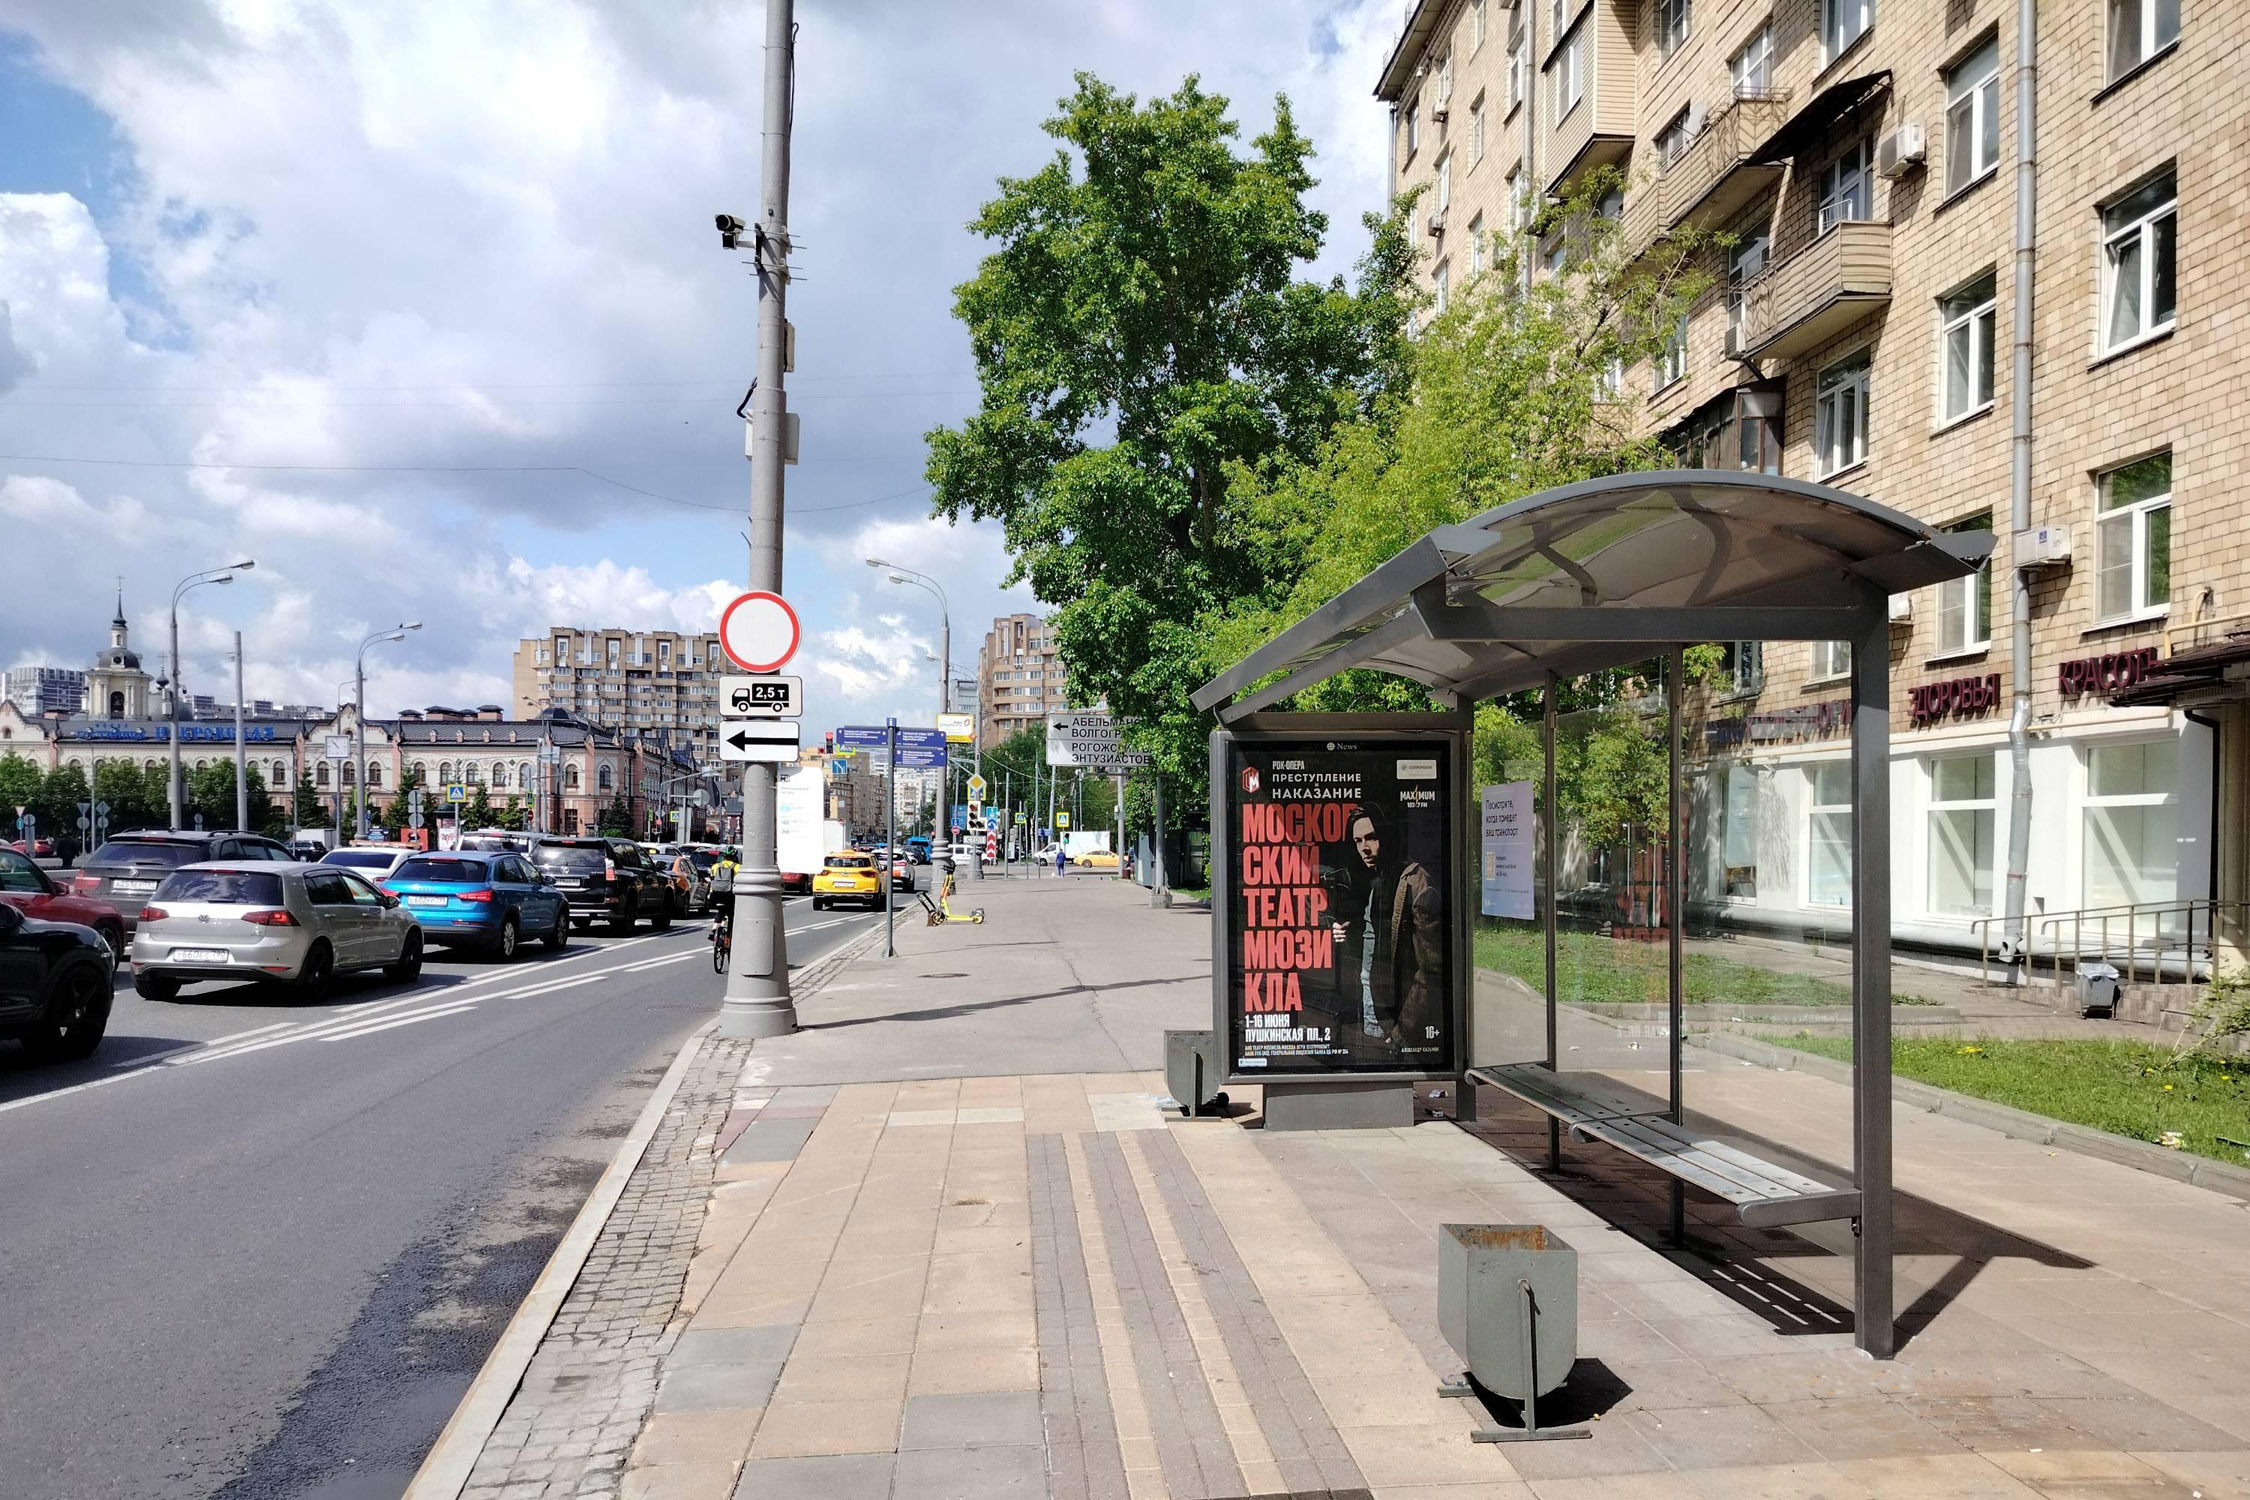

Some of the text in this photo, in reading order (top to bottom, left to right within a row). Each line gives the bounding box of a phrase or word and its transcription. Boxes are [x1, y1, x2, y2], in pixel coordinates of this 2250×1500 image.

[755, 686, 775, 700] 2,5
[1907, 673, 2000, 721] ЗДОРОВЬЯ
[1072, 728, 1122, 739] ВОЛГОГР
[1336, 742, 1358, 751] News
[1072, 753, 1151, 765] ЭНТУЗИАСТОВ
[1272, 760, 1305, 771] РОК-ОПЕРА
[1272, 773, 1361, 783] ПРЕСТУПЛЕНИЕ
[1272, 788, 1362, 799] НАКАЗАНИЕ
[1242, 841, 1320, 886] СКИЙ
[1242, 887, 1329, 928] ТЕАТР
[1243, 929, 1333, 970] МЮЗИ
[1244, 971, 1303, 1012] КЛА
[1264, 1013, 1290, 1028] ИЮНЯ
[1245, 1028, 1304, 1042] ПУШКИНСКАЯ
[1324, 1027, 1331, 1041] 2
[1425, 1025, 1440, 1039] 16+
